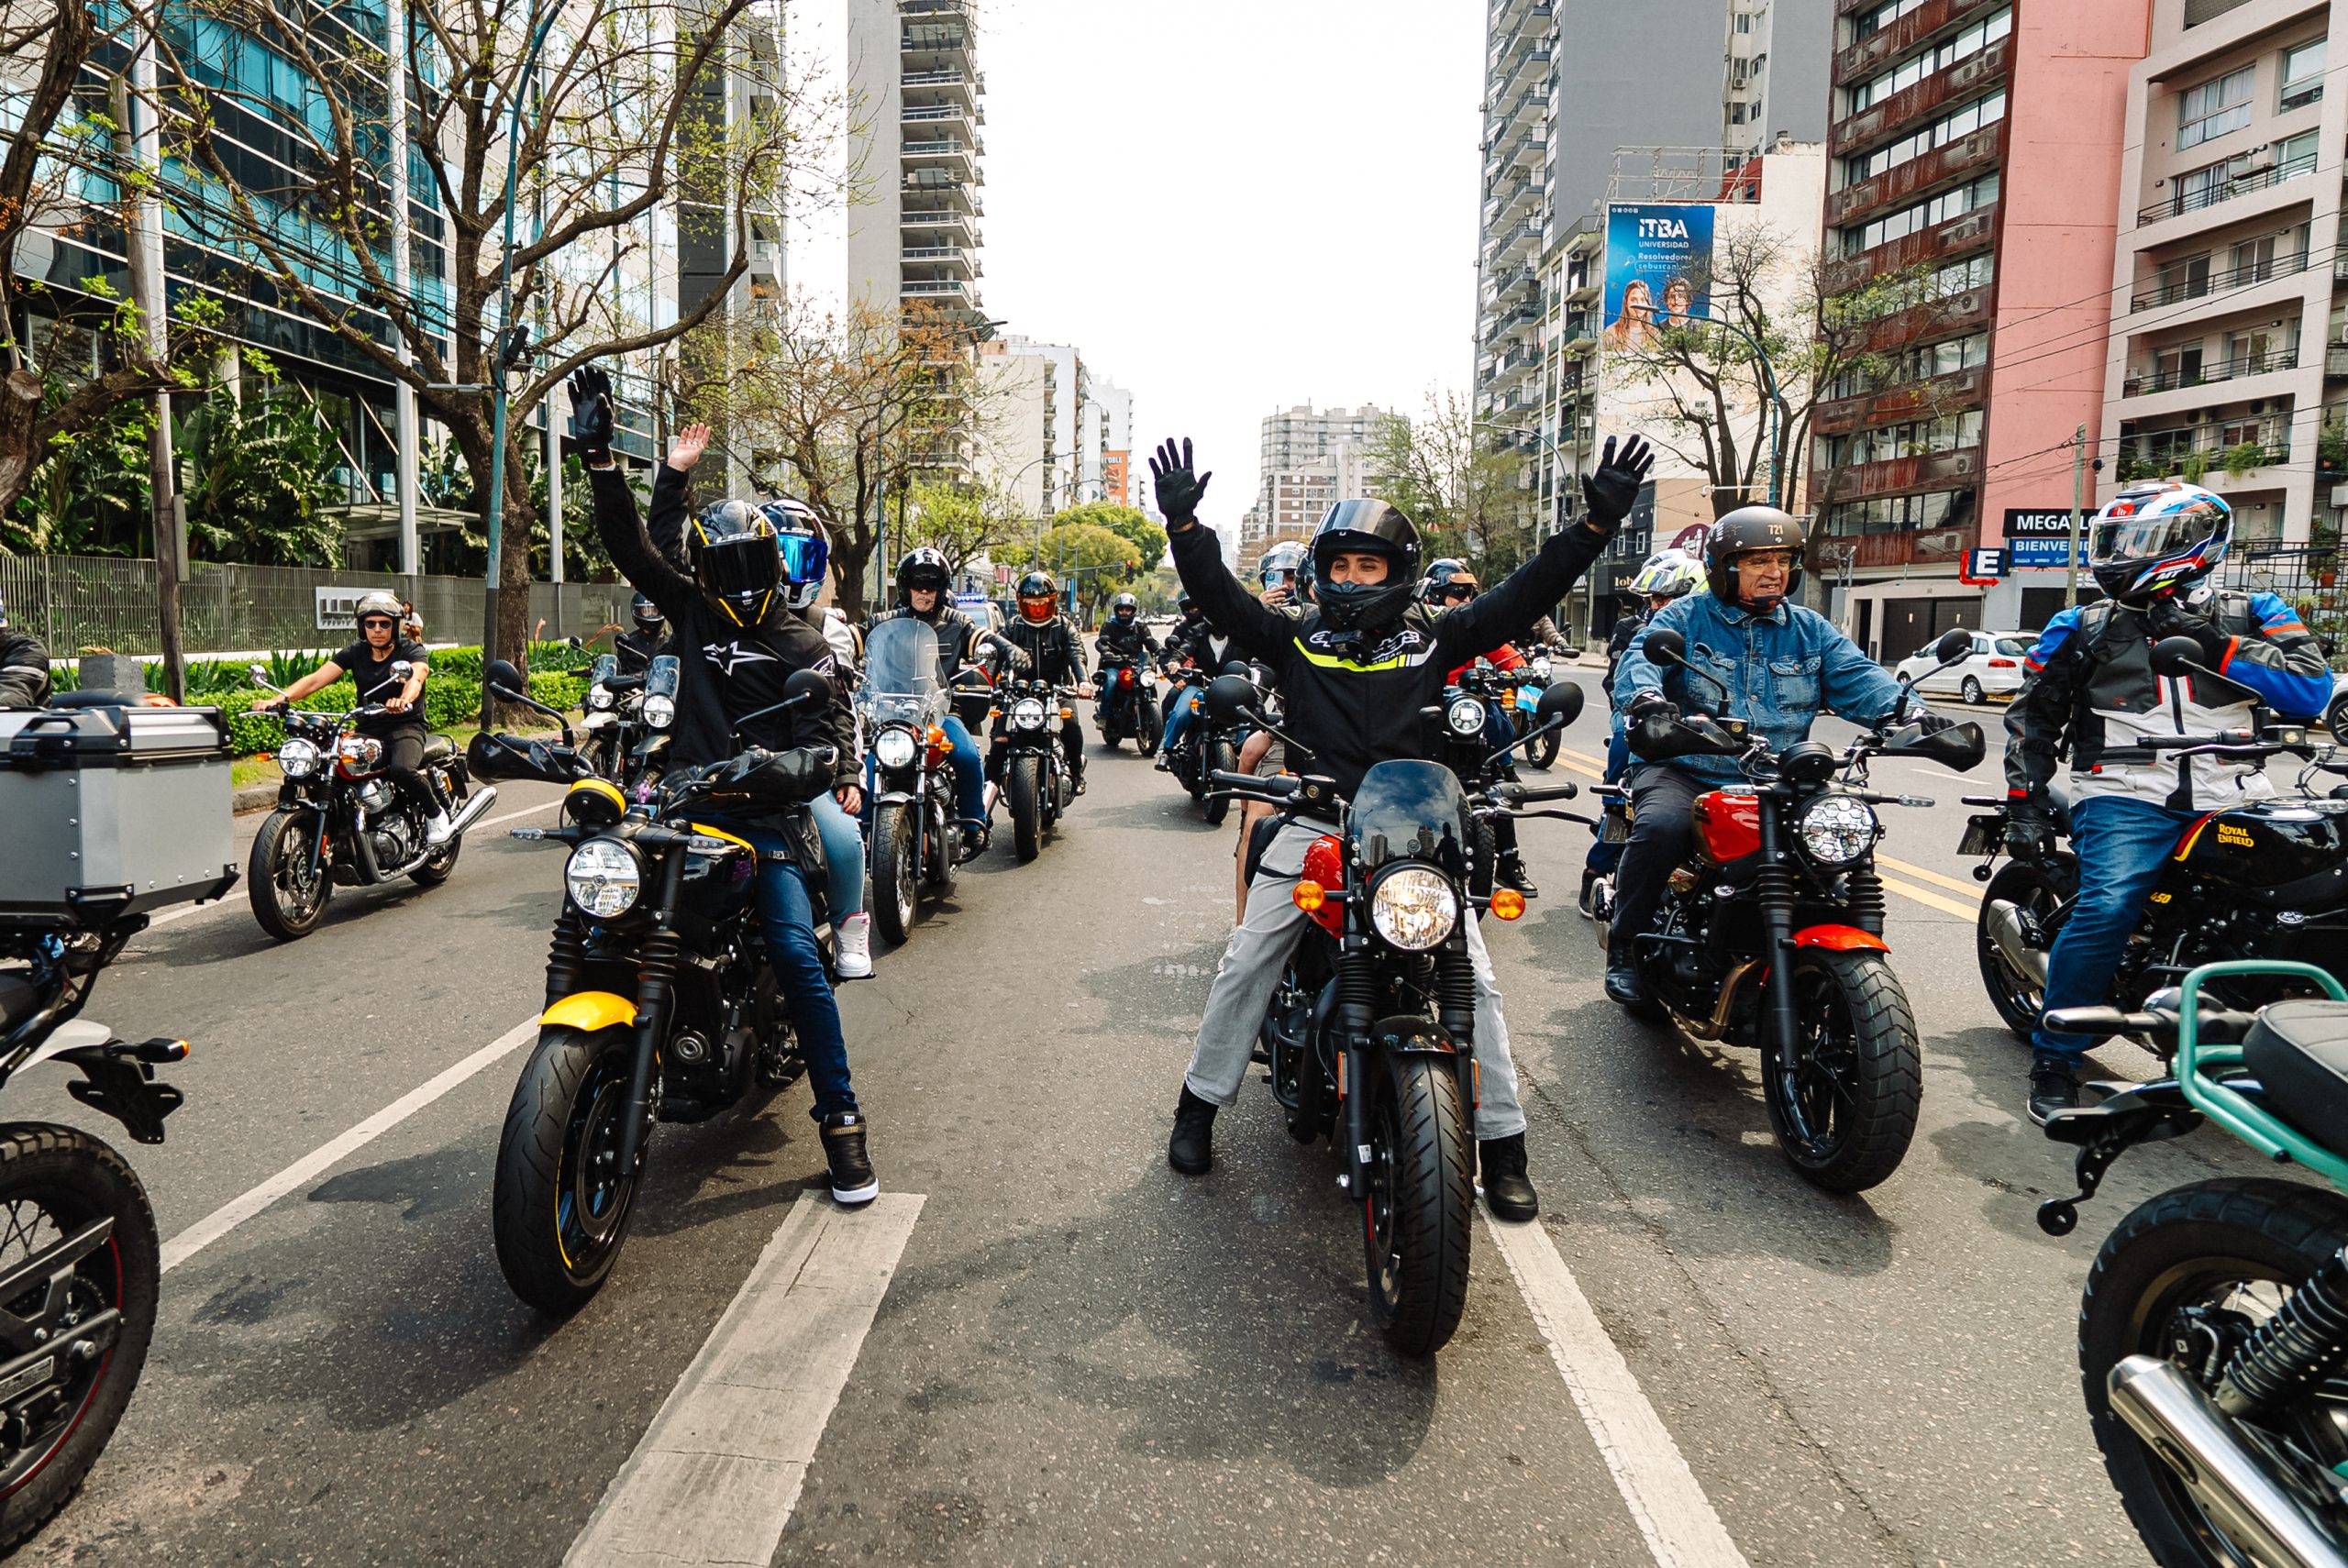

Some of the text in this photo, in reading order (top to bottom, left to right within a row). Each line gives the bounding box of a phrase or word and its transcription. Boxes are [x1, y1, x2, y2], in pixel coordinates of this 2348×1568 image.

[1768, 525, 1783, 535] 721
[1976, 550, 2000, 574] E
[2155, 569, 2184, 580] MT
[2219, 823, 2249, 836] ROYAL
[2218, 834, 2254, 847] ENFIELD
